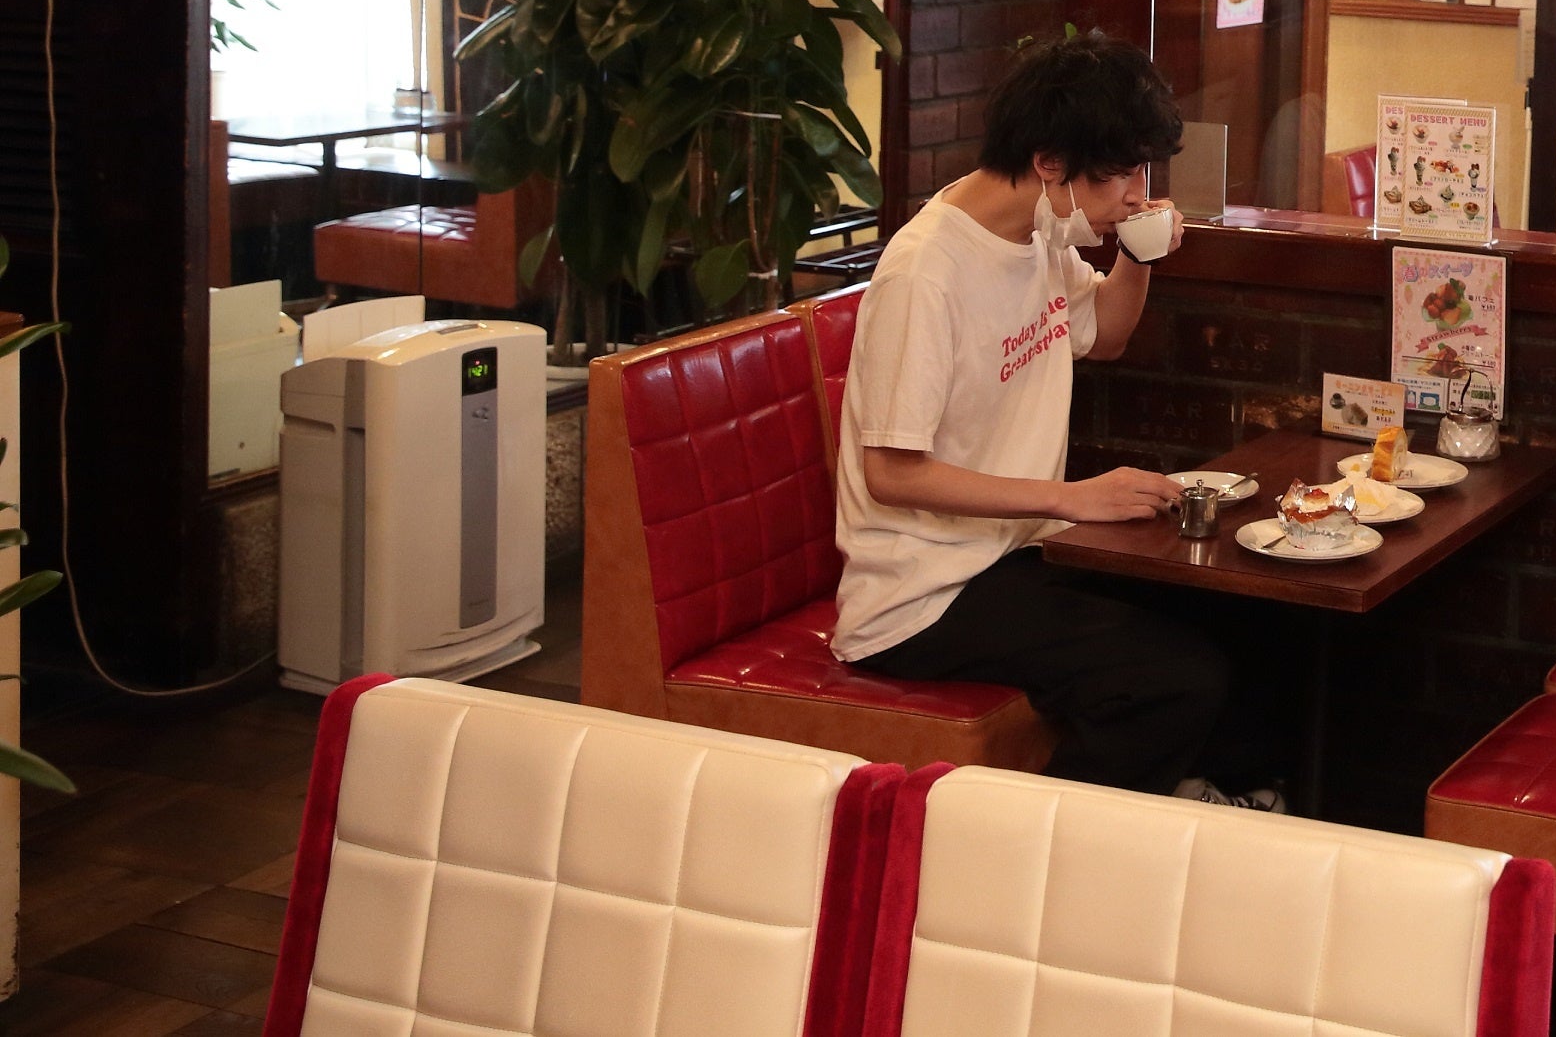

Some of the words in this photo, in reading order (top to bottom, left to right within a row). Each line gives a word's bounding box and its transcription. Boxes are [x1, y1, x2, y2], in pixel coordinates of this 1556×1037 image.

[1410, 114, 1456, 126] DESSERT
[1460, 117, 1487, 128] MENU
[1001, 321, 1038, 358] Today
